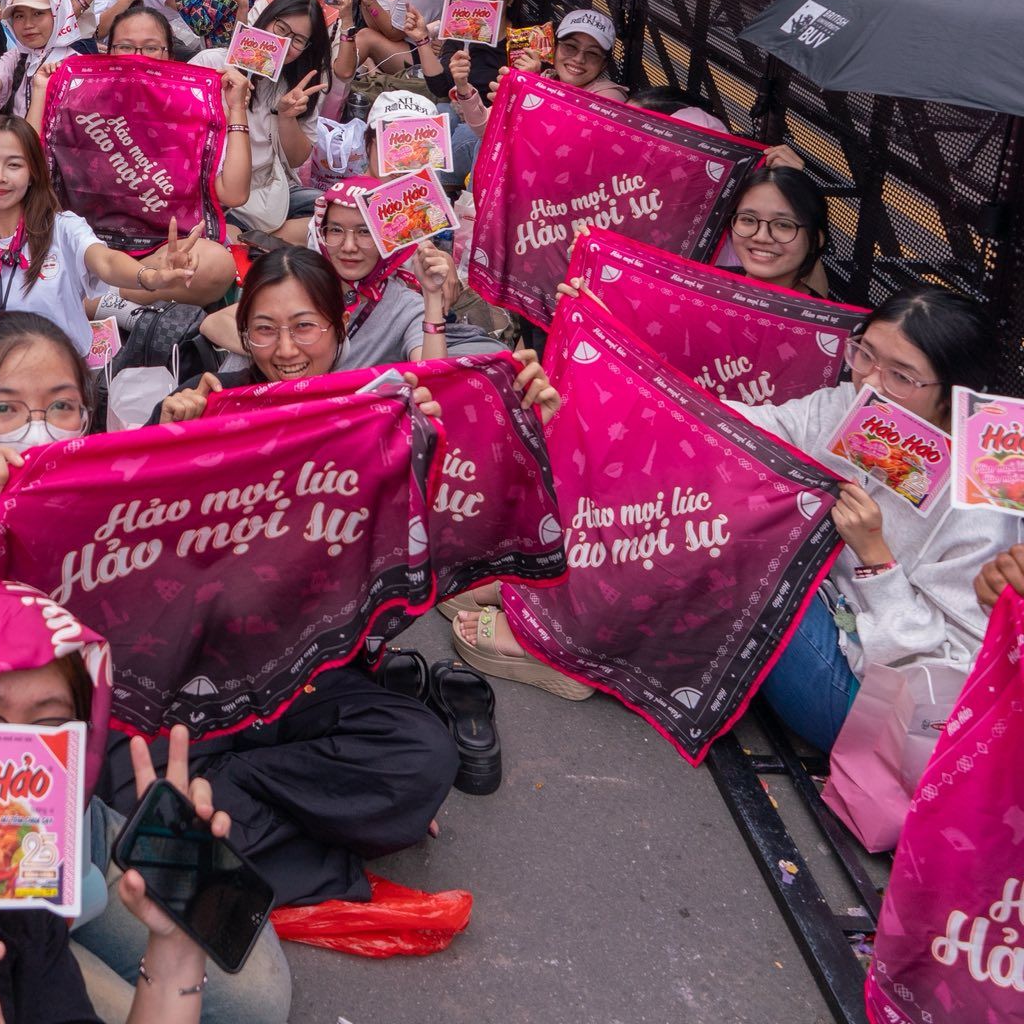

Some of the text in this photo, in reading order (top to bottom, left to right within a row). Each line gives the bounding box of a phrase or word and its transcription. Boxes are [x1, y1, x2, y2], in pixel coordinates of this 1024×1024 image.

[452, 6, 492, 19] Hảo Hảo
[239, 36, 278, 53] Hảo Hảo
[798, 26, 831, 49] BUV
[107, 115, 175, 195] Hảo mọi lúc
[389, 125, 438, 146] Hảo Hảo
[75, 112, 169, 213] Hảo mọi sự
[377, 184, 429, 221] Hảo Hảo
[530, 172, 647, 219] Hảo mọi lúc
[514, 218, 567, 255] Hảo
[631, 188, 663, 223] sự
[714, 354, 753, 380] lúc
[737, 371, 775, 406] sự
[861, 416, 943, 465] Hảo Hảo
[980, 422, 1024, 452] Hả
[442, 448, 477, 482] úc
[94, 460, 360, 543] Hảo mọi lúc
[432, 482, 485, 523] sự
[620, 491, 666, 530] mọi
[672, 486, 713, 516] lúc
[50, 498, 369, 605] Hảo mọi sự
[611, 517, 675, 571] mọi
[685, 514, 731, 559] sự
[21, 832, 57, 868] 25
[931, 909, 1024, 993] Hả
